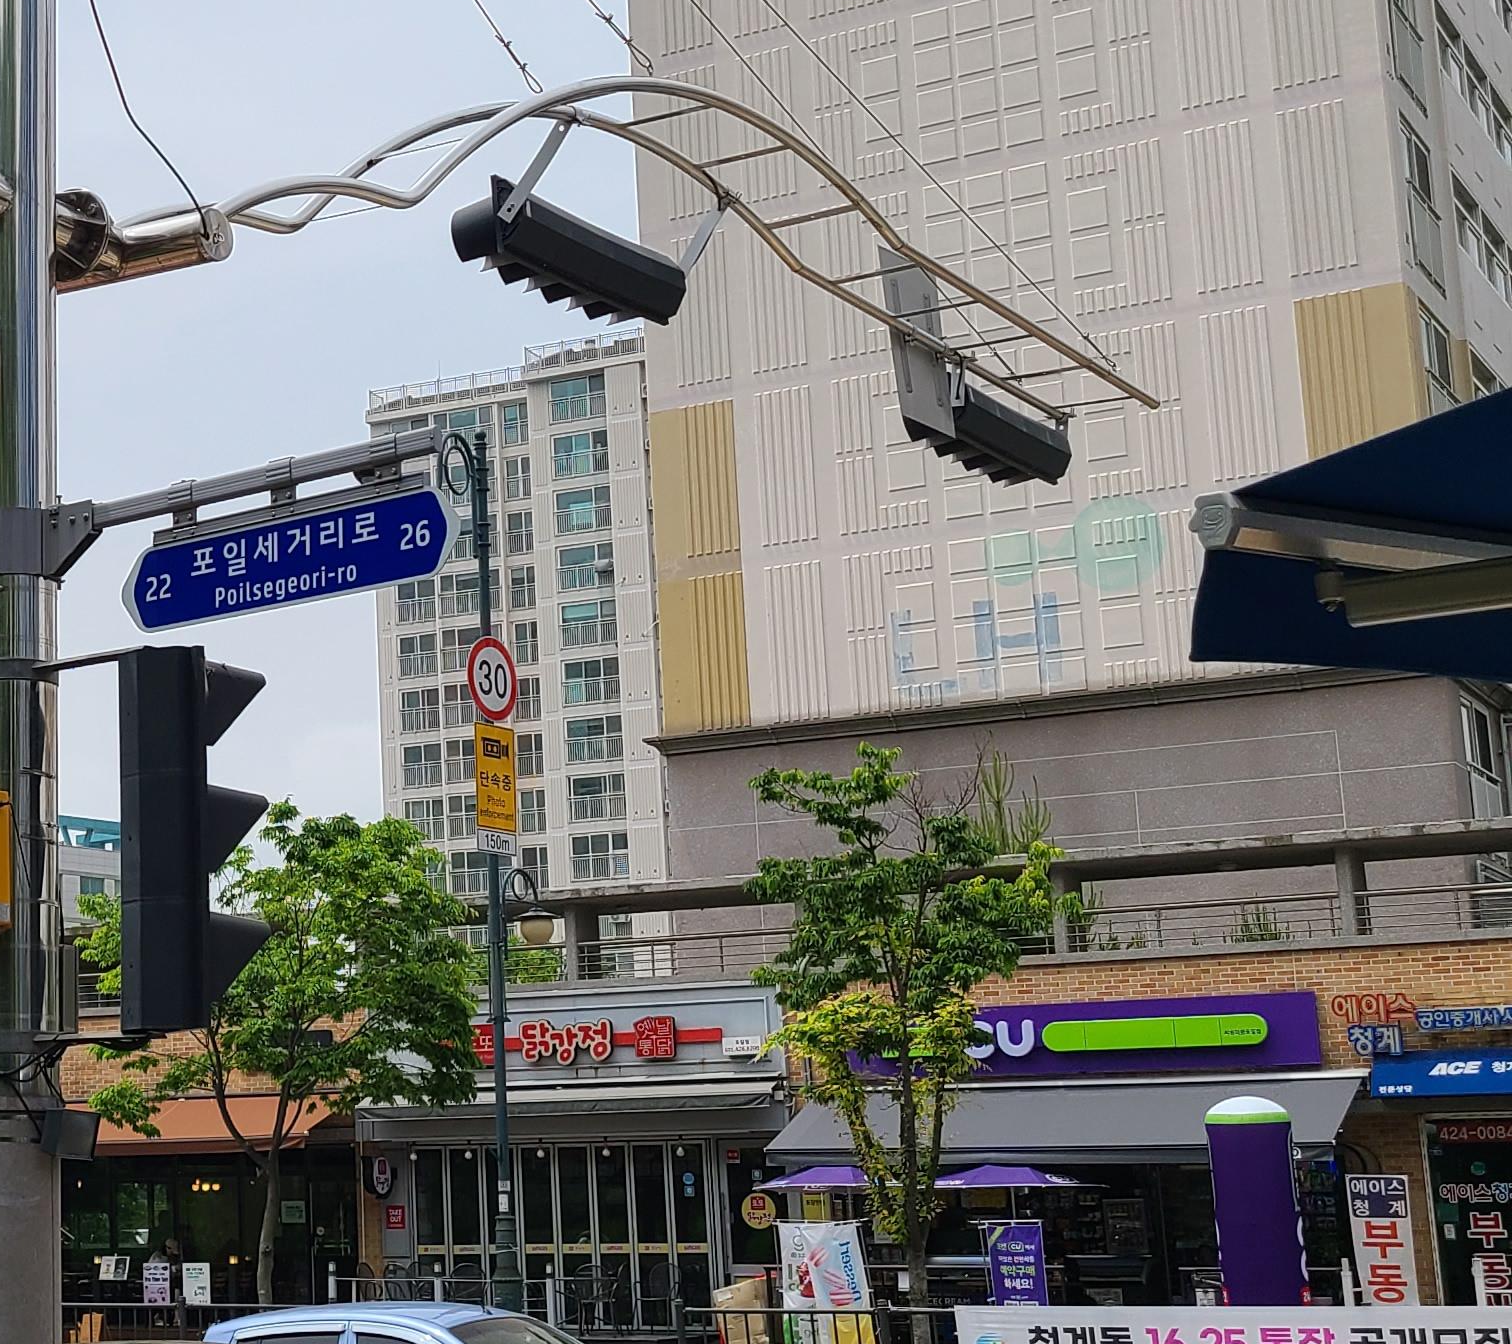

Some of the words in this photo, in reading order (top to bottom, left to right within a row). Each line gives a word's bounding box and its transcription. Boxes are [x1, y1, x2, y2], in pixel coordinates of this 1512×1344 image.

[145, 574, 172, 602] 22
[190, 511, 380, 578] 포일세거리로
[399, 519, 431, 551] 26
[214, 562, 357, 609] Poilsegeori-ro
[478, 659, 508, 699] 30
[480, 770, 512, 792] 단속중
[485, 832, 510, 852] 150m
[1332, 993, 1416, 1023] 에이스
[1417, 1009, 1499, 1029] 공인중개사
[520, 1018, 612, 1065] 닭강정
[1348, 1024, 1404, 1056] 청계
[1428, 1060, 1483, 1076] ACE
[1350, 1178, 1405, 1196] 에이스
[1004, 1278, 1034, 1290] 하세요!
